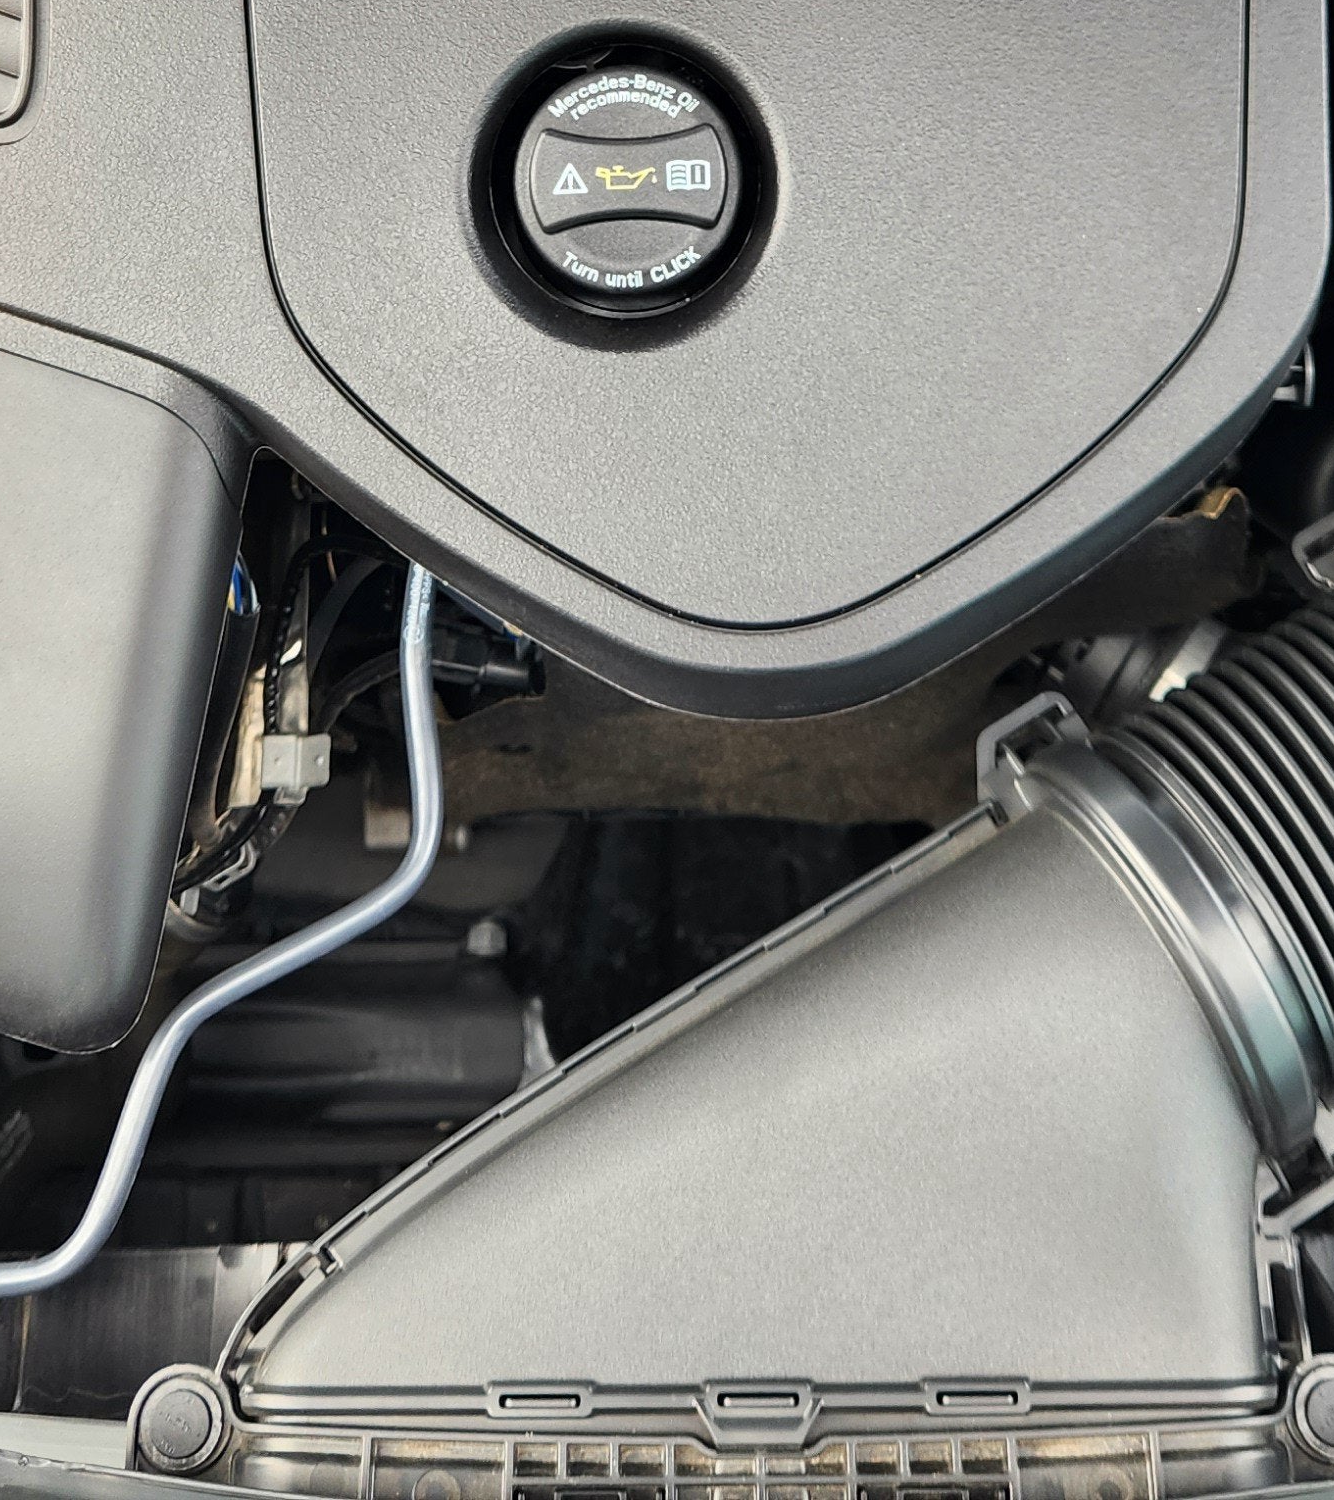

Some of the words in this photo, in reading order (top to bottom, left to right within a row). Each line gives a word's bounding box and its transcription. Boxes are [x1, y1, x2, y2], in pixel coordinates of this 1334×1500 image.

[547, 74, 677, 118] Mercedes-Benz
[677, 90, 701, 114] Oil
[570, 90, 681, 121] recommended
[561, 251, 599, 283] Turn
[605, 270, 644, 288] until
[650, 245, 702, 283] CLICK
